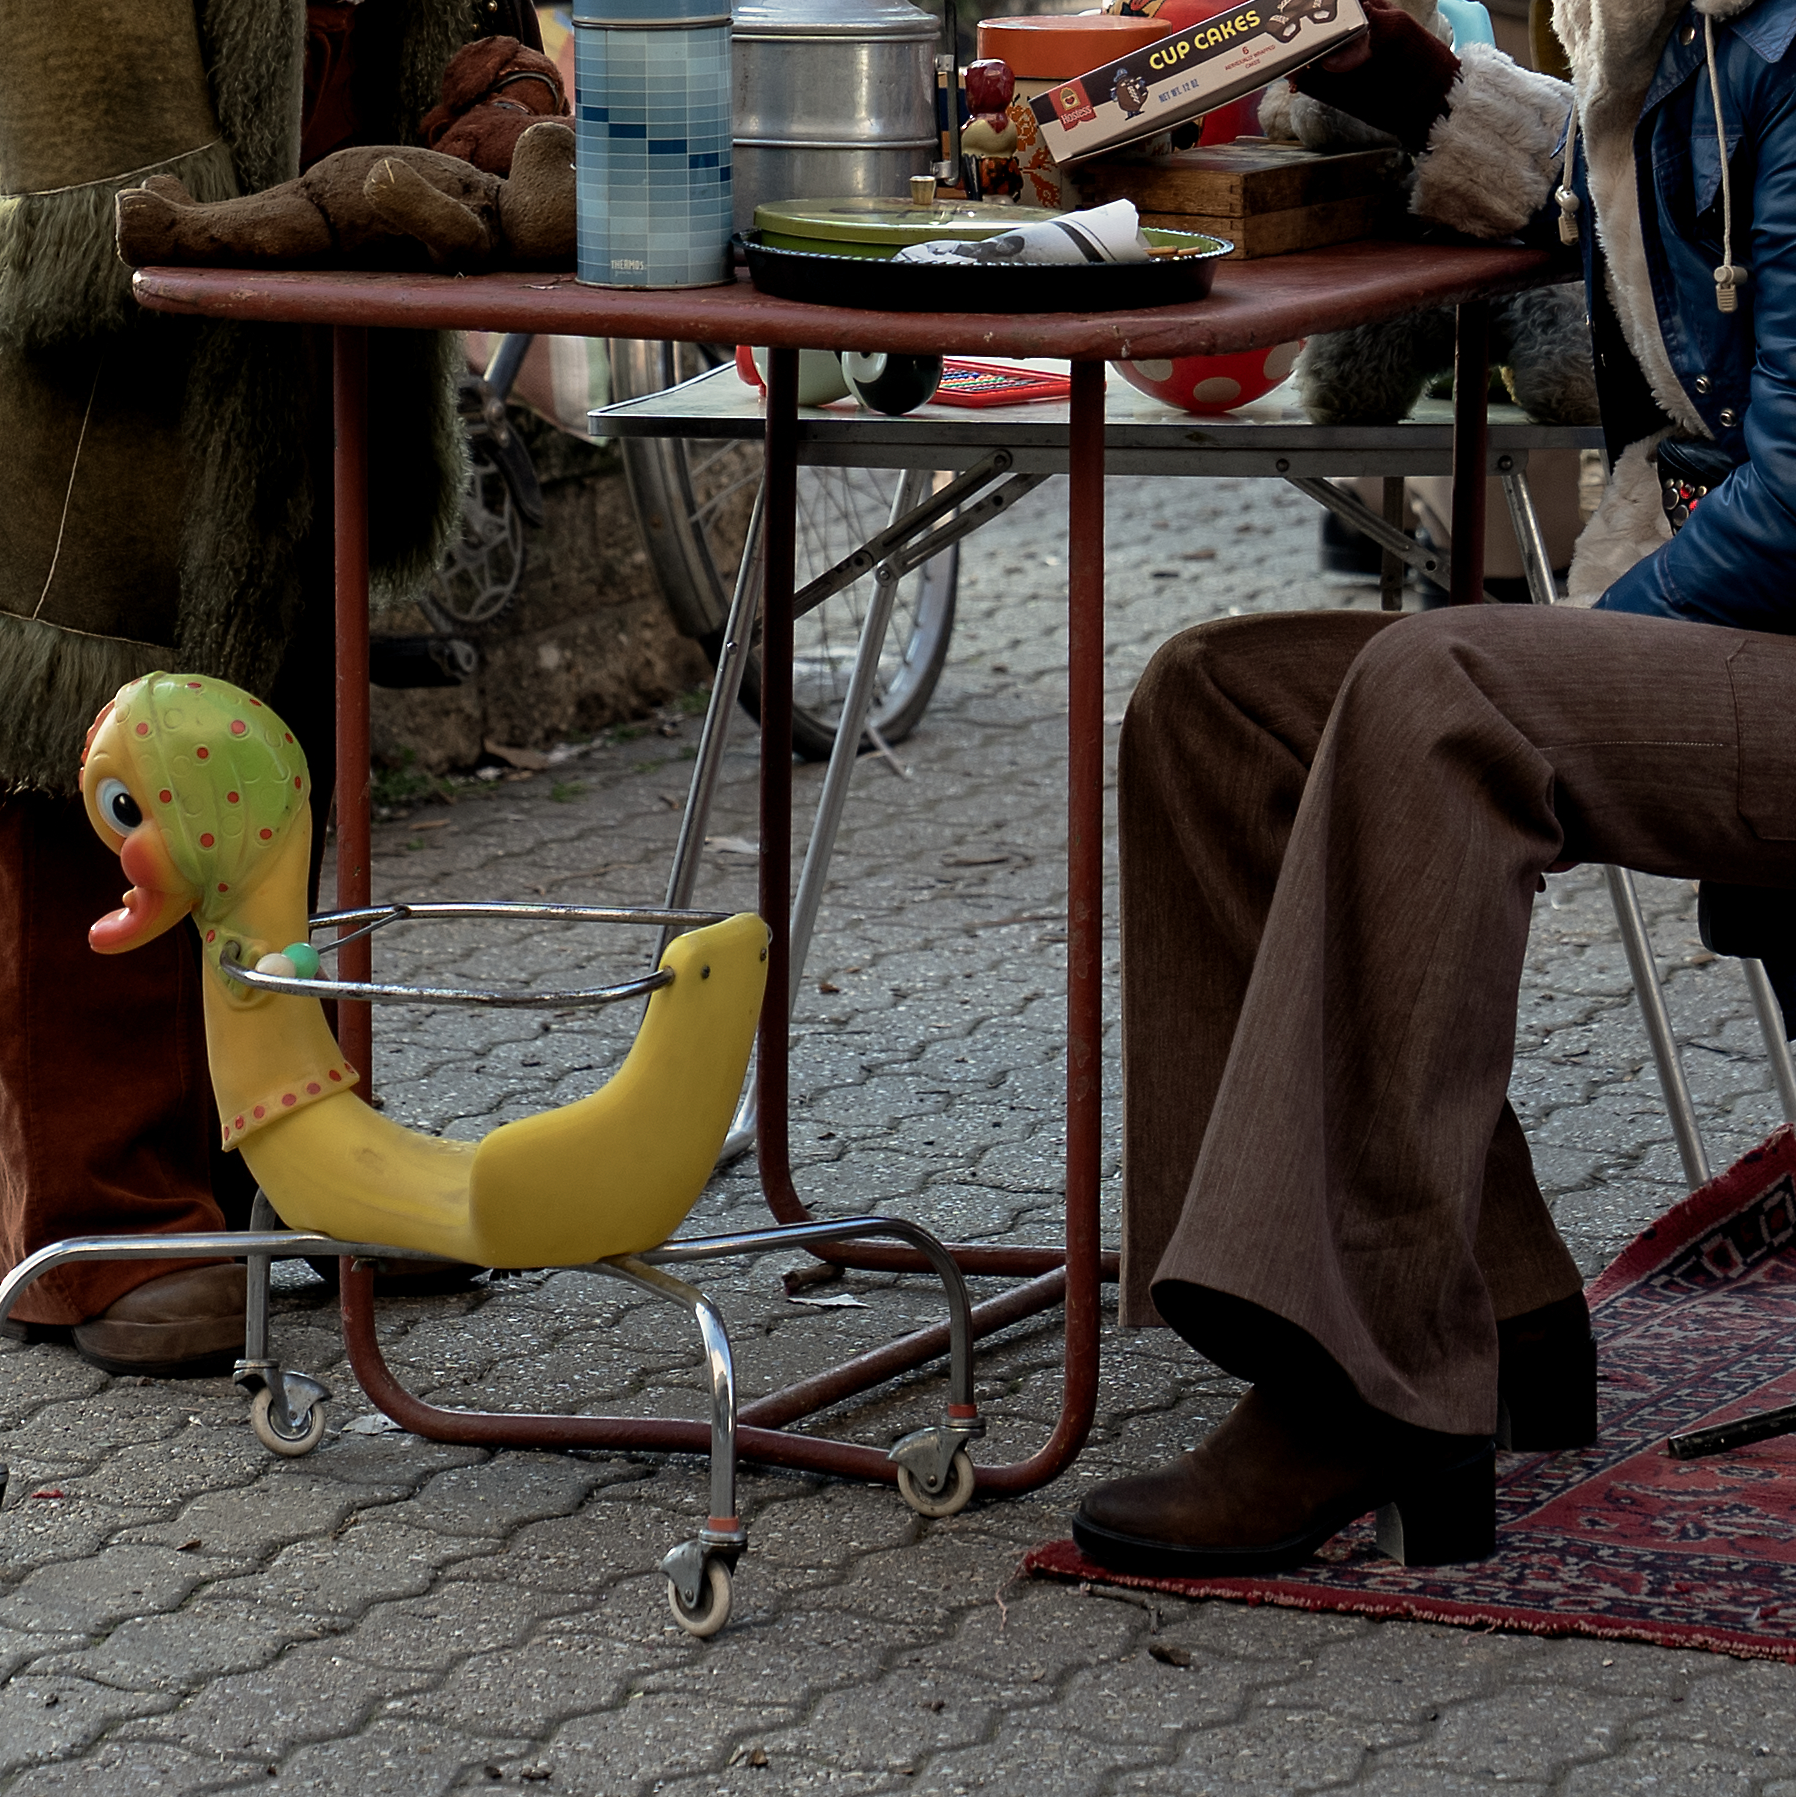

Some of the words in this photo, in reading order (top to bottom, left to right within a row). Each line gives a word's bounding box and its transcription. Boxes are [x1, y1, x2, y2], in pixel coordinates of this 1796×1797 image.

[1149, 40, 1190, 70] CUP
[1194, 9, 1261, 50] CAKES
[1241, 45, 1250, 55] 6
[1158, 91, 1171, 103] NET
[1182, 82, 1191, 92] 12
[610, 258, 645, 270] THERMOS
